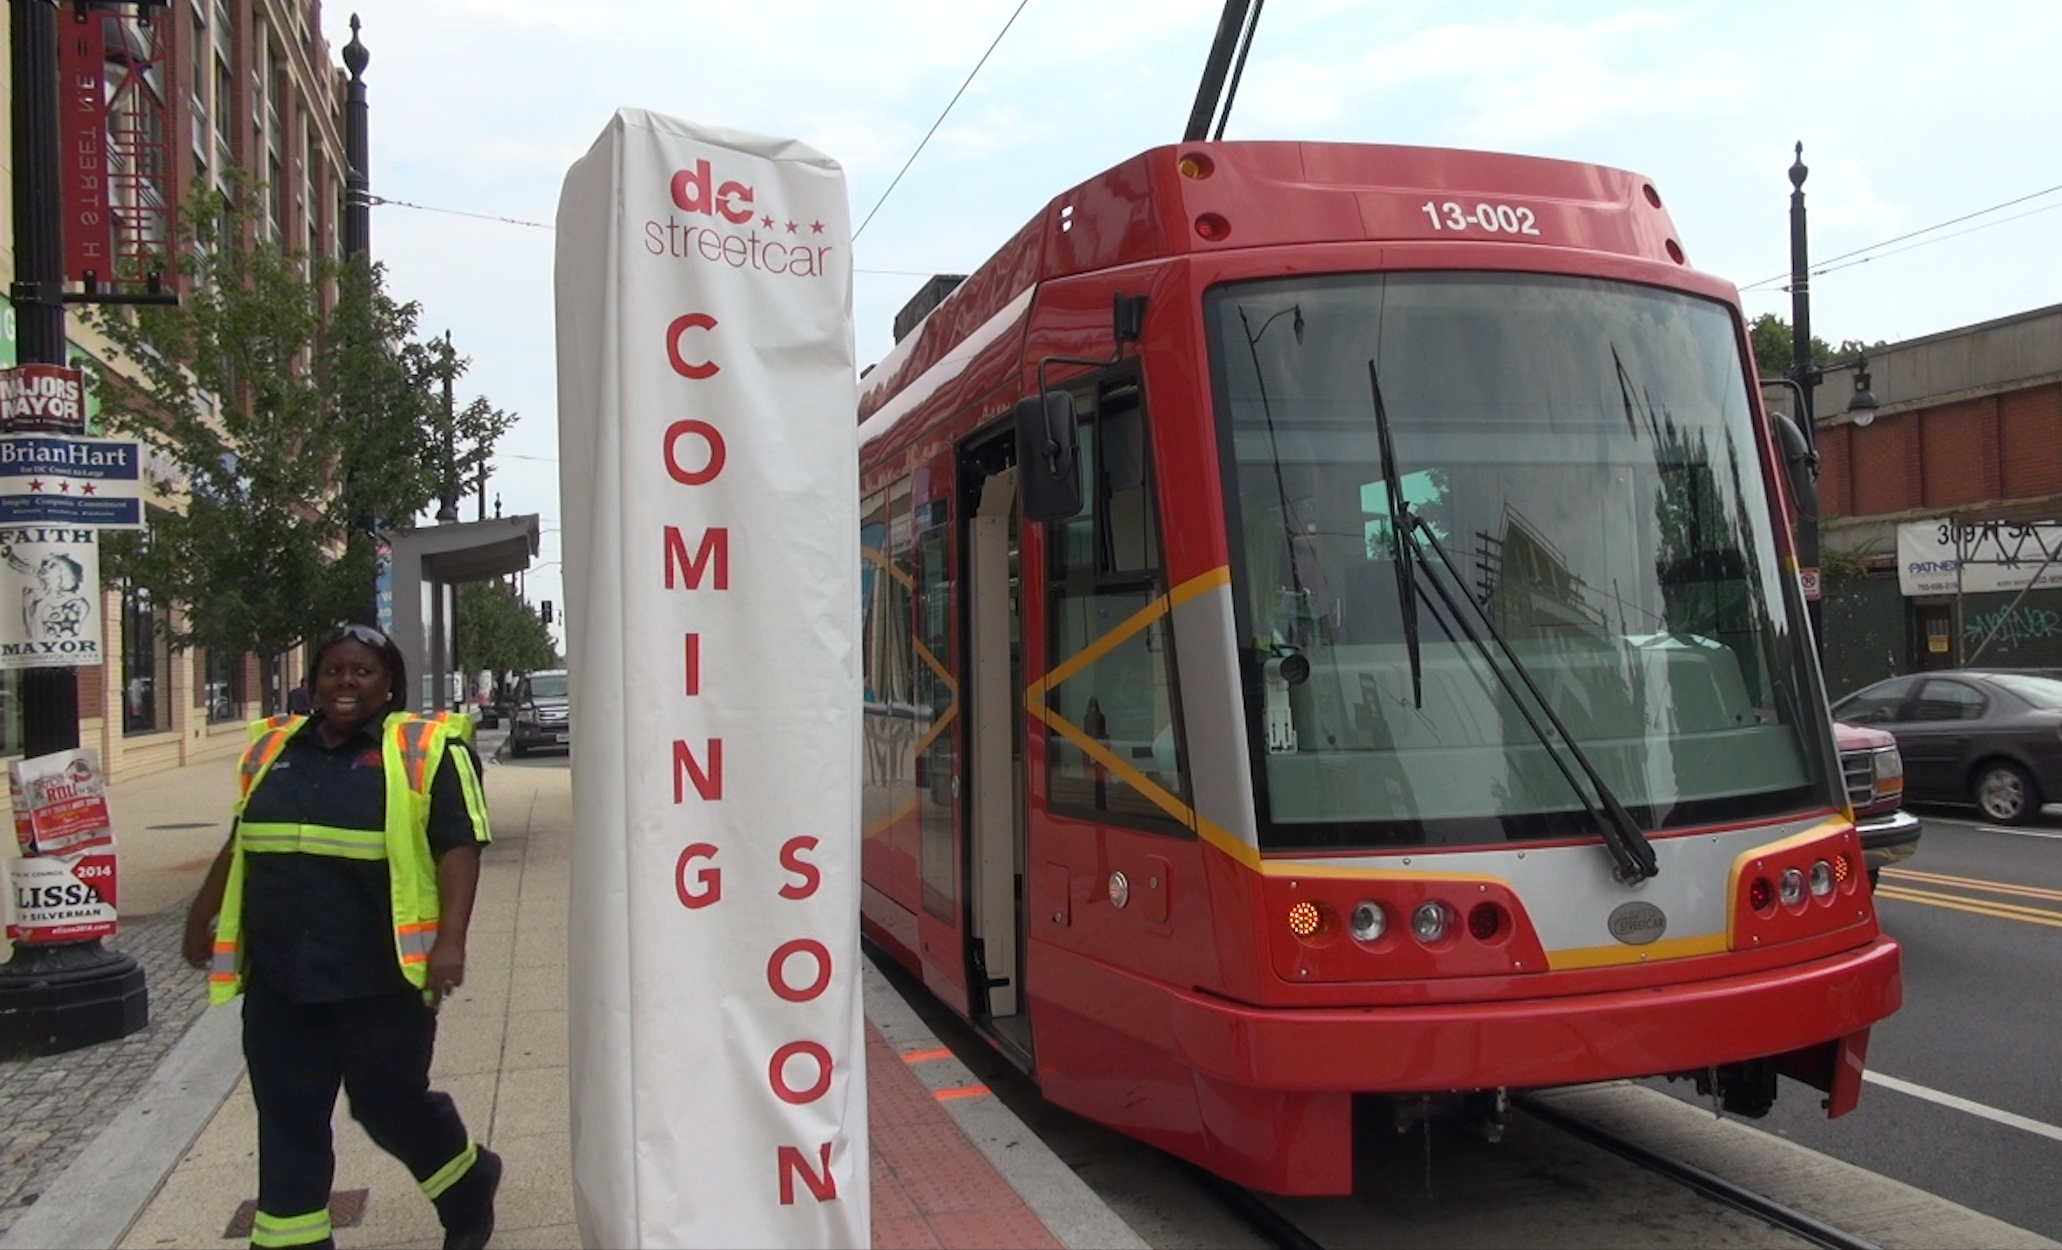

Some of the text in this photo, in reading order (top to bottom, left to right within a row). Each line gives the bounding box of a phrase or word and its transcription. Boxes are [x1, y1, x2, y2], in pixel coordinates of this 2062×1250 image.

[670, 158, 755, 224] dc
[1421, 200, 1541, 236] 13-002
[644, 215, 833, 277] streetcar
[0, 375, 79, 401] MAJORS
[2, 397, 79, 420] MAYOR
[0, 529, 94, 544] FAITH
[662, 312, 729, 910] COMING
[1, 641, 97, 656] MAYOR
[77, 866, 112, 878] 2014
[30, 908, 101, 921] SILVERMAN
[766, 835, 837, 1206] SOON
